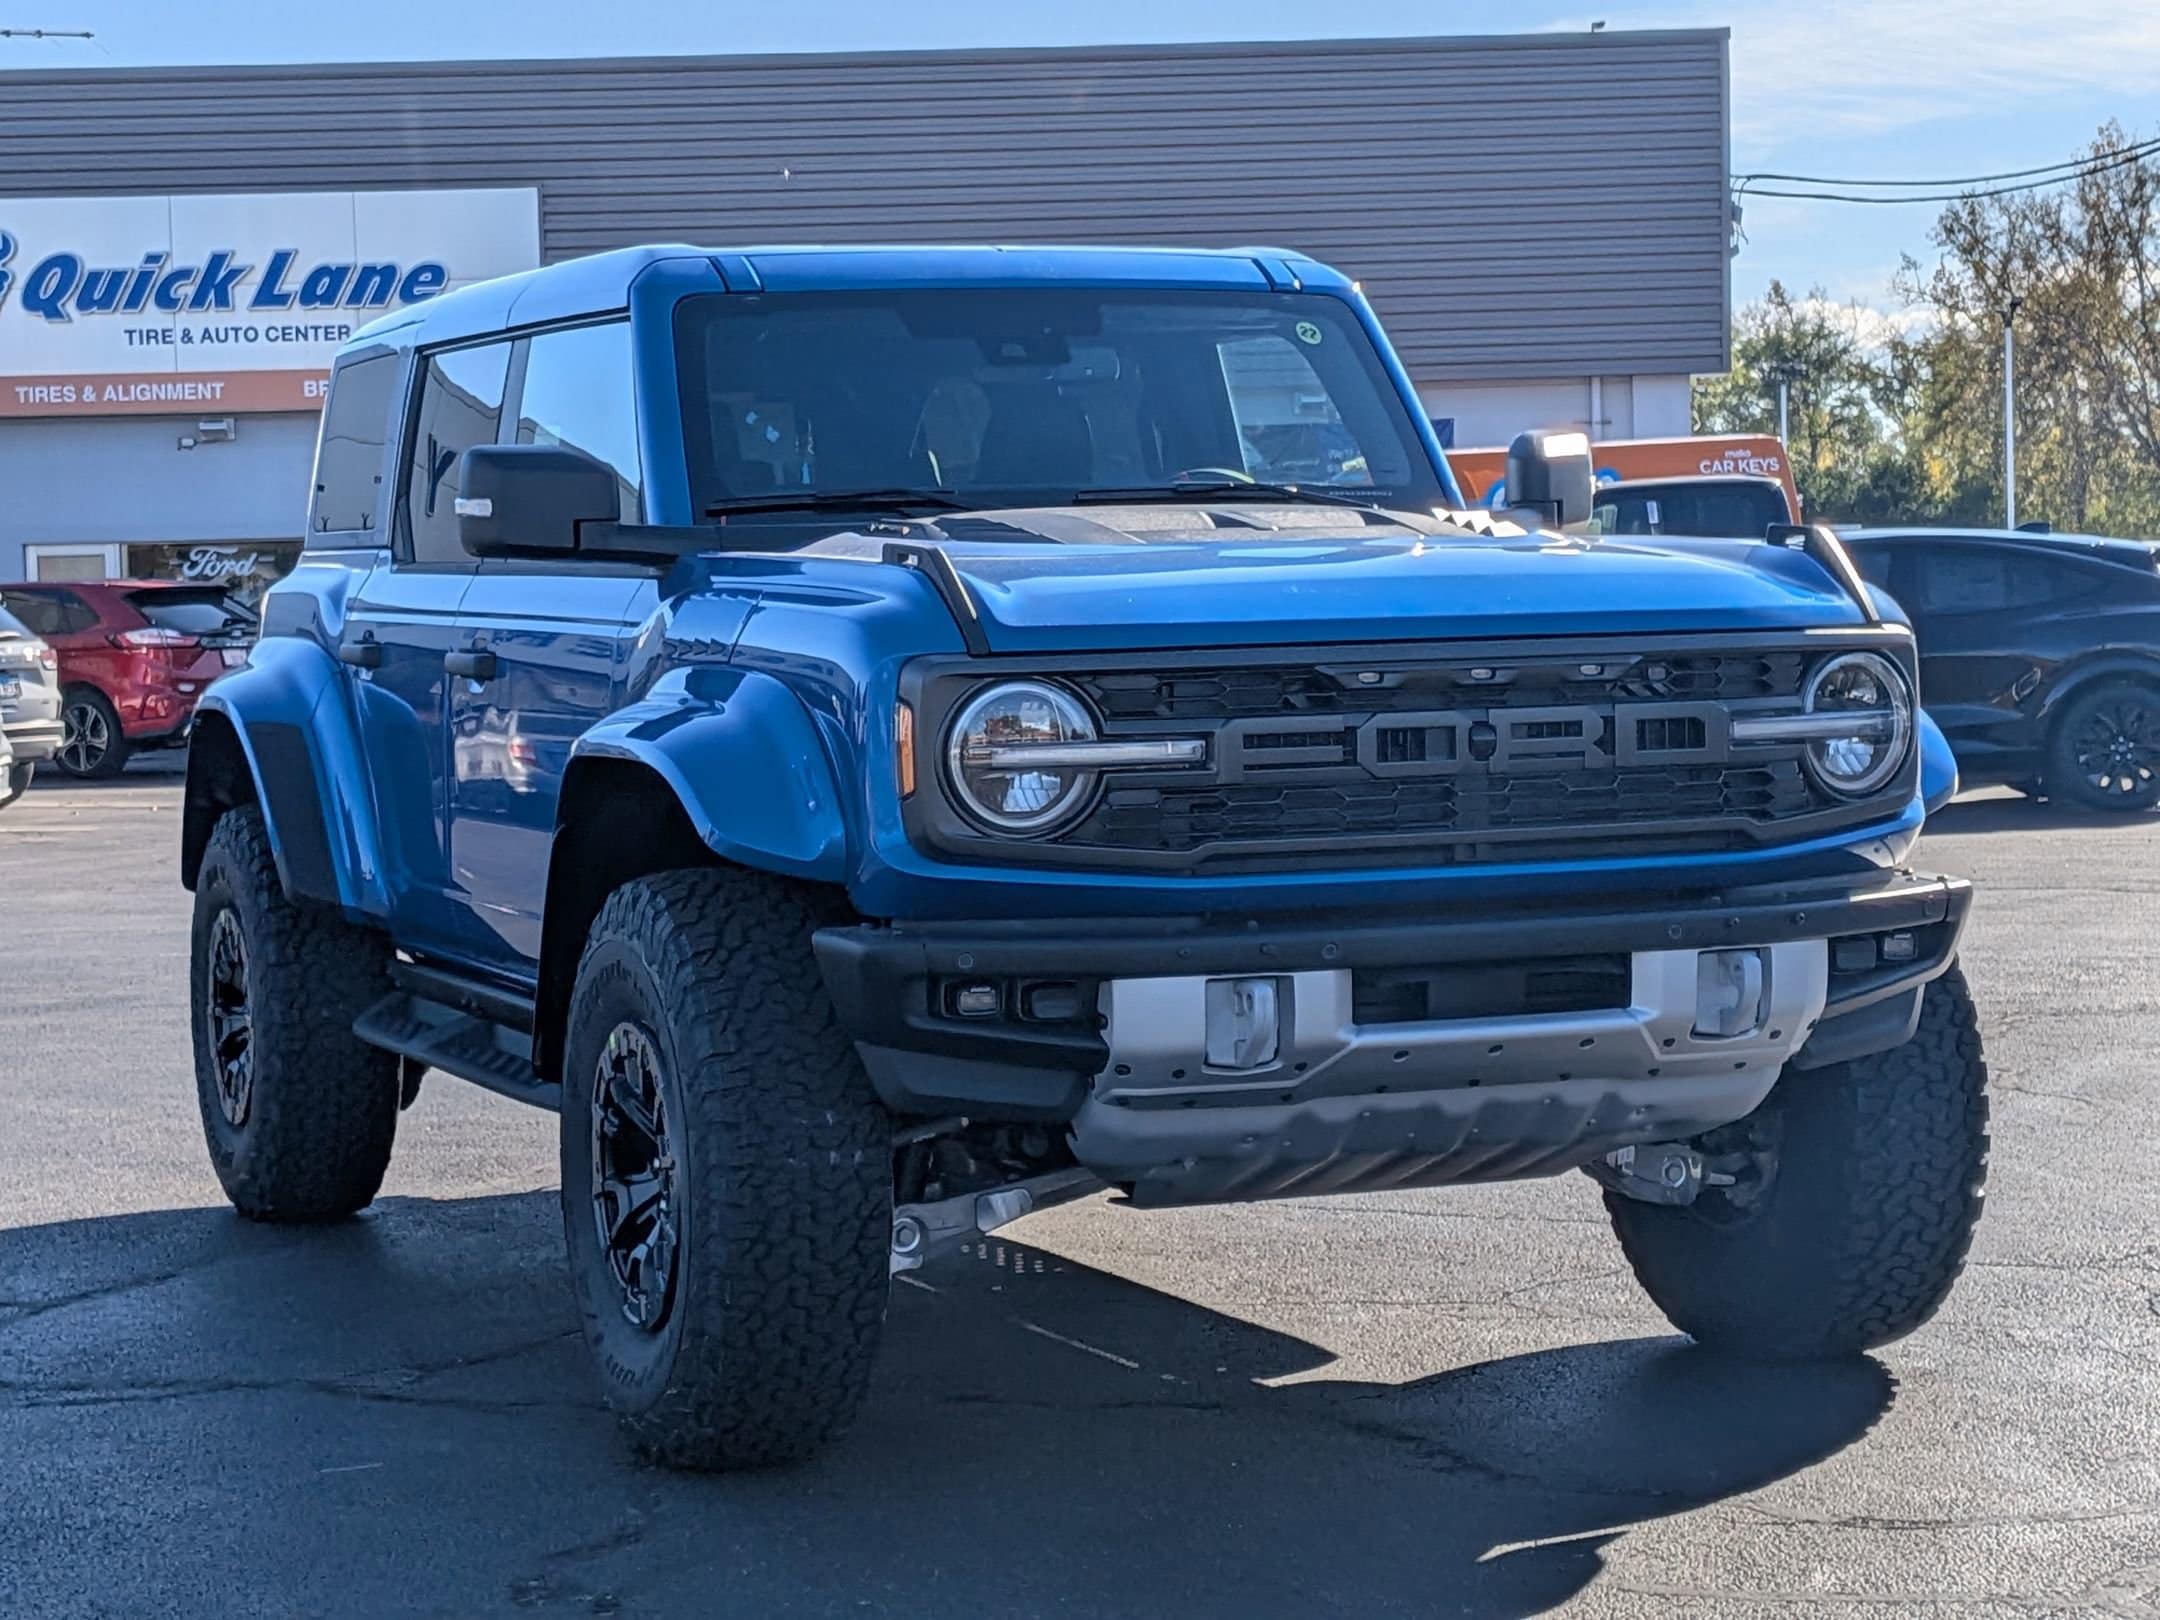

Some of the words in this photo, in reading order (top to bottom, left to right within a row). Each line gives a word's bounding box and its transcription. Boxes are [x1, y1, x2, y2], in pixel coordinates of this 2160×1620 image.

[20, 249, 254, 323] Quick
[248, 249, 449, 311] Lane
[124, 328, 174, 346] TIRE
[180, 327, 194, 344] &
[200, 326, 259, 344] AUTO
[265, 324, 350, 342] CENTER
[15, 386, 77, 404] TIRES
[82, 385, 97, 402] &
[103, 382, 225, 401] ALIGNMENT
[1699, 459, 1735, 474] CAR
[1738, 457, 1780, 473] KEYS
[182, 545, 258, 577] Ford
[1216, 701, 1729, 784] FORD
